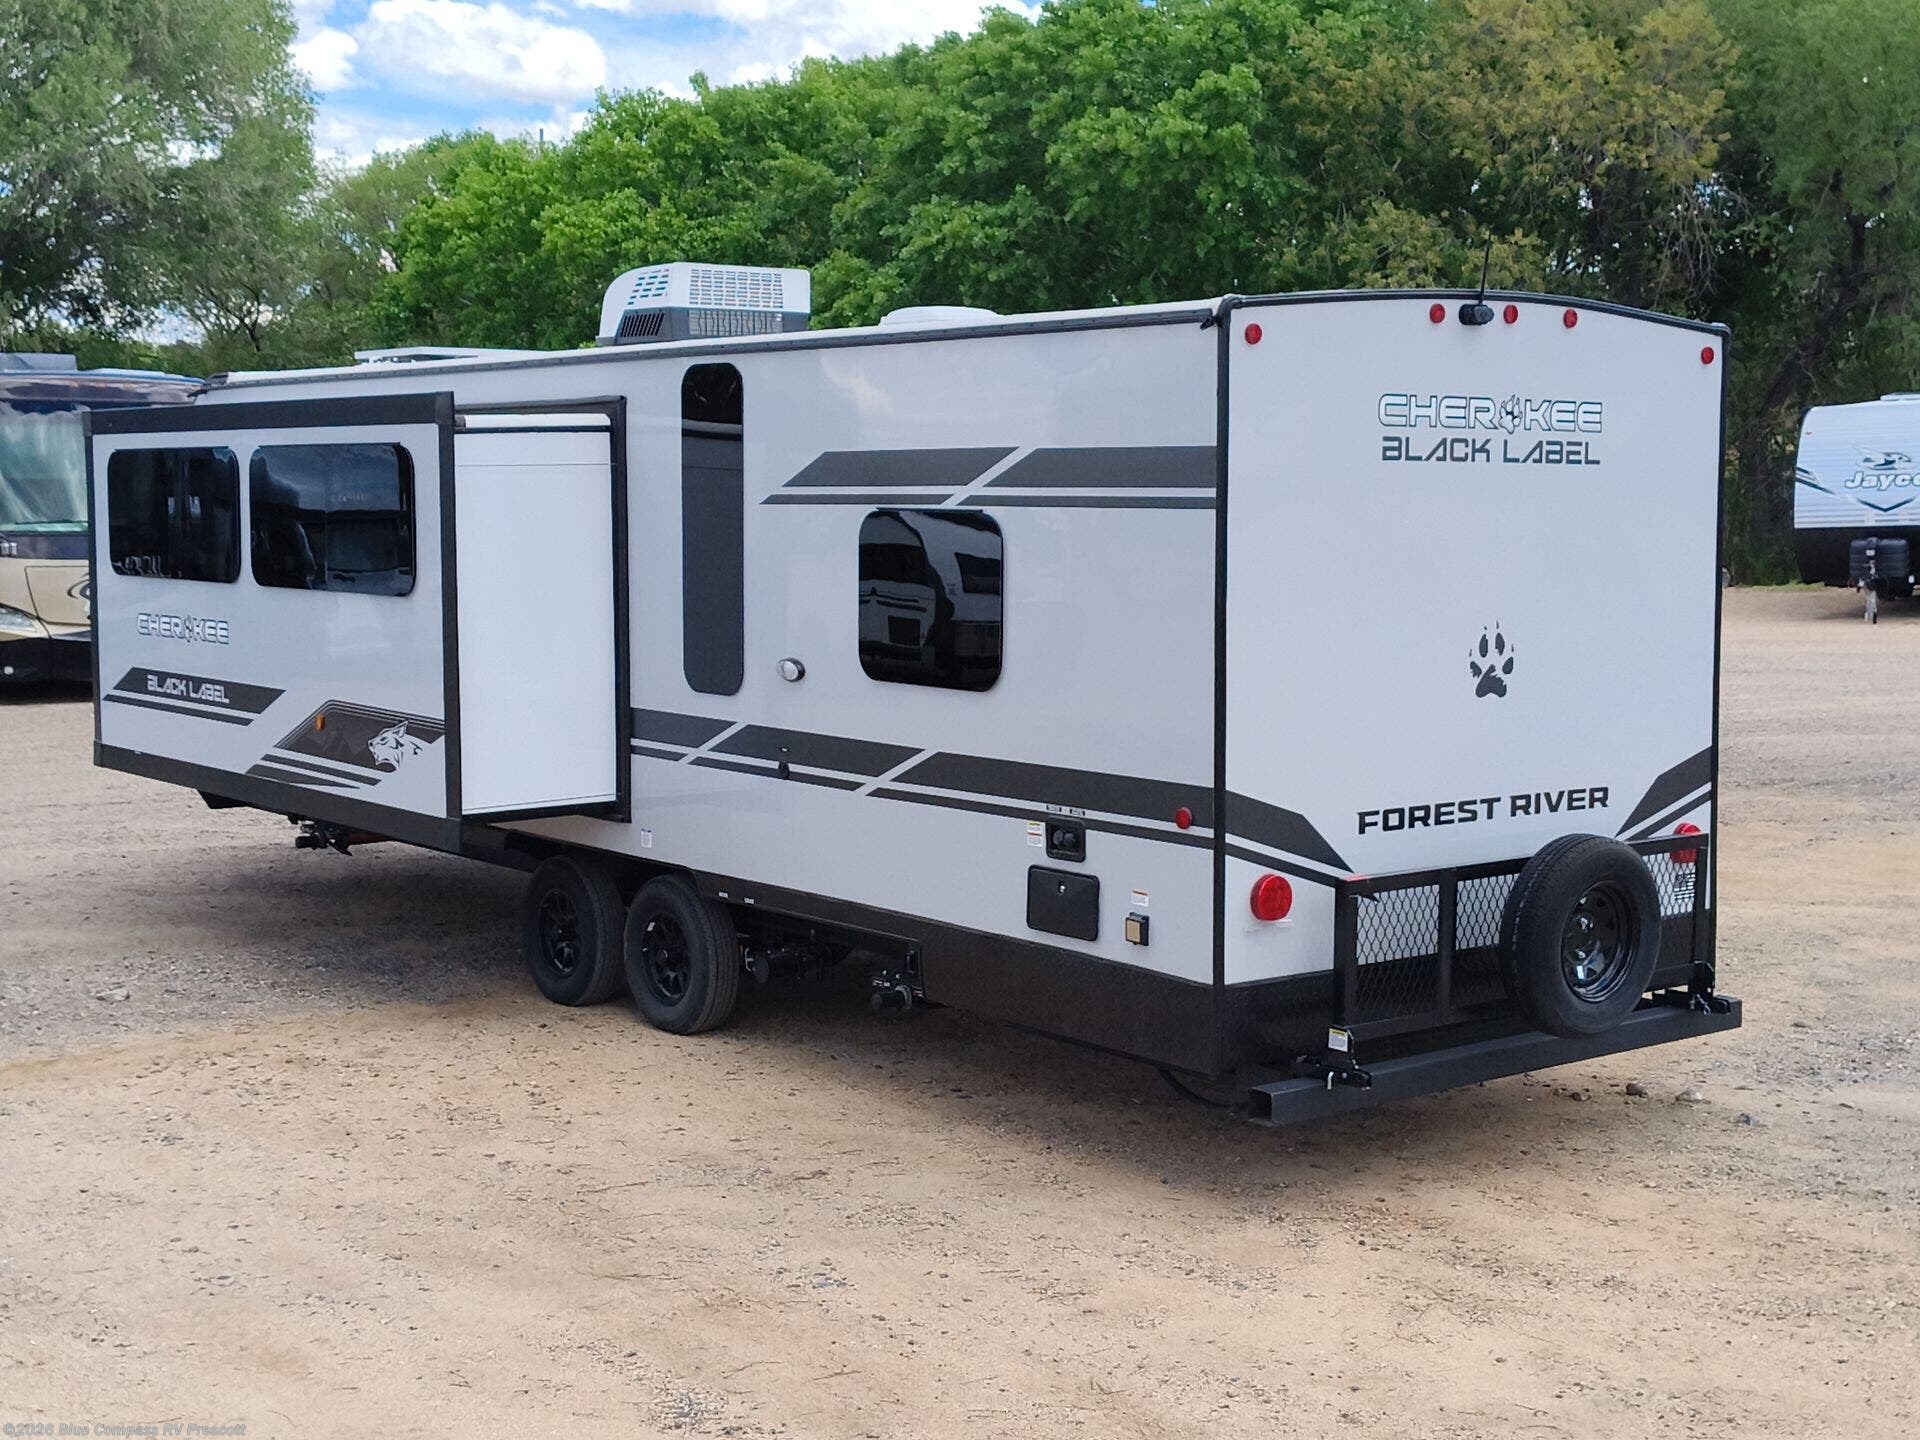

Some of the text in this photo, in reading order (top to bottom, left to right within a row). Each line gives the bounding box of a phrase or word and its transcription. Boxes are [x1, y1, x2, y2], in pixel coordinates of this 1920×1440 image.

[1382, 436, 1601, 465] BLACK LABEL
[146, 674, 230, 704] BLACK LABEL
[1357, 787, 1609, 835] FOREST RIVER
